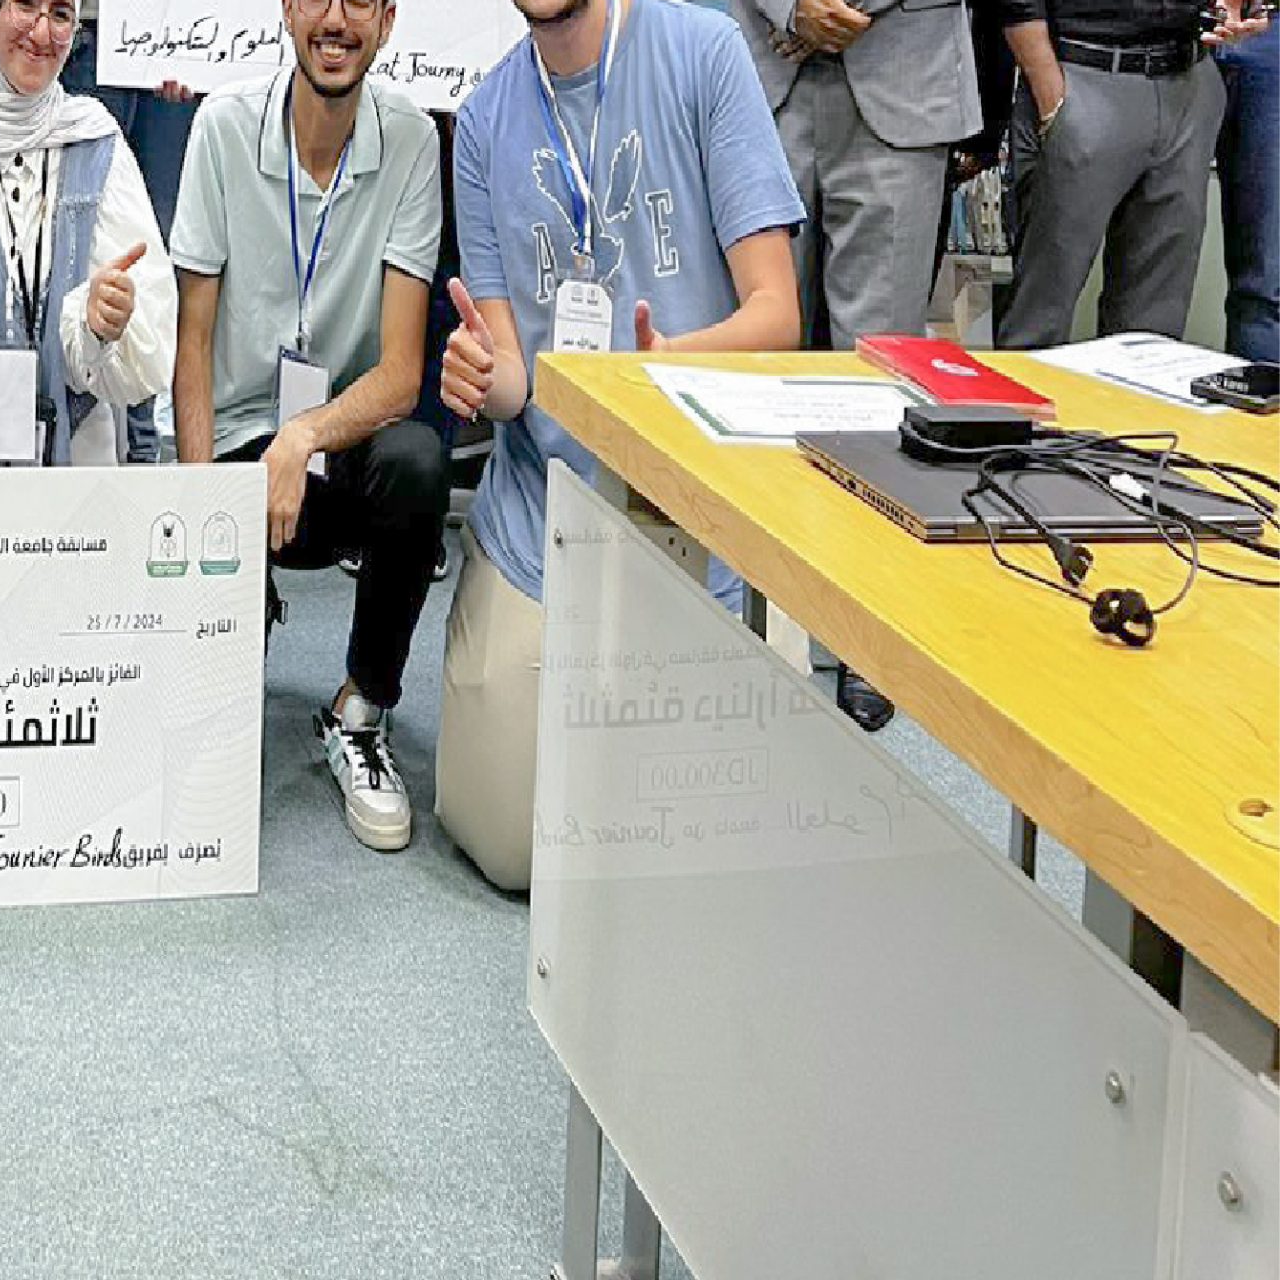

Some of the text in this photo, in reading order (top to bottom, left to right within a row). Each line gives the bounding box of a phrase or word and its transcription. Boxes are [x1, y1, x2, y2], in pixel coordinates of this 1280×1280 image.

[643, 191, 680, 278] E
[12, 537, 53, 557] جامعة
[56, 537, 108, 557] مسابقة
[196, 619, 237, 639] التاريخ
[23, 664, 54, 688] الأول
[58, 666, 104, 687] بالمركز
[107, 663, 140, 686] الفائز
